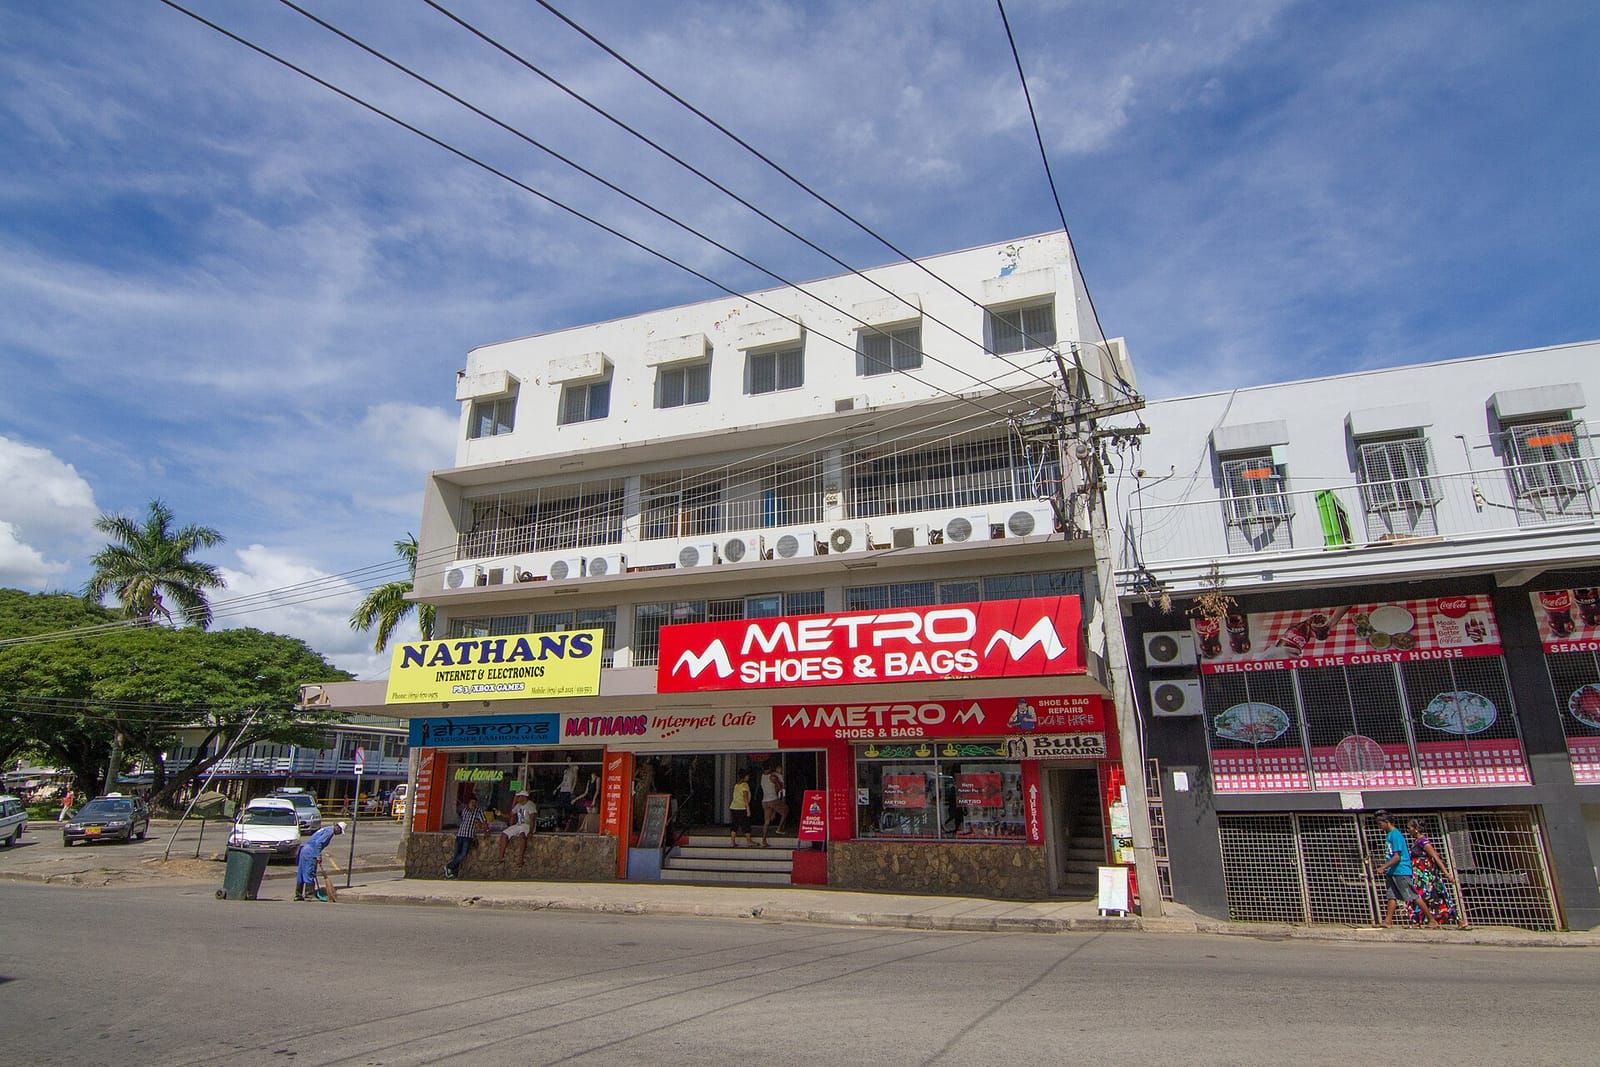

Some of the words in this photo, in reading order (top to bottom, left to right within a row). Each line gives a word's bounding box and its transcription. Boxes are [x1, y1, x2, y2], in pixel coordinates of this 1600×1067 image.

[741, 608, 976, 655] METRO
[400, 633, 593, 669] NATHANS
[1551, 642, 1600, 653] SEAFO
[740, 656, 842, 684] SHOES
[853, 655, 876, 677] &
[883, 650, 978, 677] BAGS
[1214, 661, 1285, 673] WELCOME
[1291, 660, 1309, 668] TO
[1315, 656, 1345, 666] THE
[1350, 653, 1402, 665] CURRY
[1410, 648, 1465, 659] HOUSE
[435, 669, 477, 682] INTERNET
[477, 669, 485, 681] &
[487, 666, 545, 680] ELECTRONICS
[496, 682, 525, 692] GAMES
[1039, 699, 1061, 707] SHOE
[1072, 698, 1089, 706] BAG
[814, 703, 946, 729] METRO
[1048, 706, 1083, 714] REPAIRS
[565, 714, 648, 737] NATHANS
[651, 713, 715, 730] Internet
[721, 711, 756, 727] Cafe
[835, 728, 874, 739] SHOES
[878, 728, 887, 737] &
[890, 726, 924, 737] BAGS
[1033, 735, 1100, 748] Bula
[1033, 747, 1105, 756] BARGAINS
